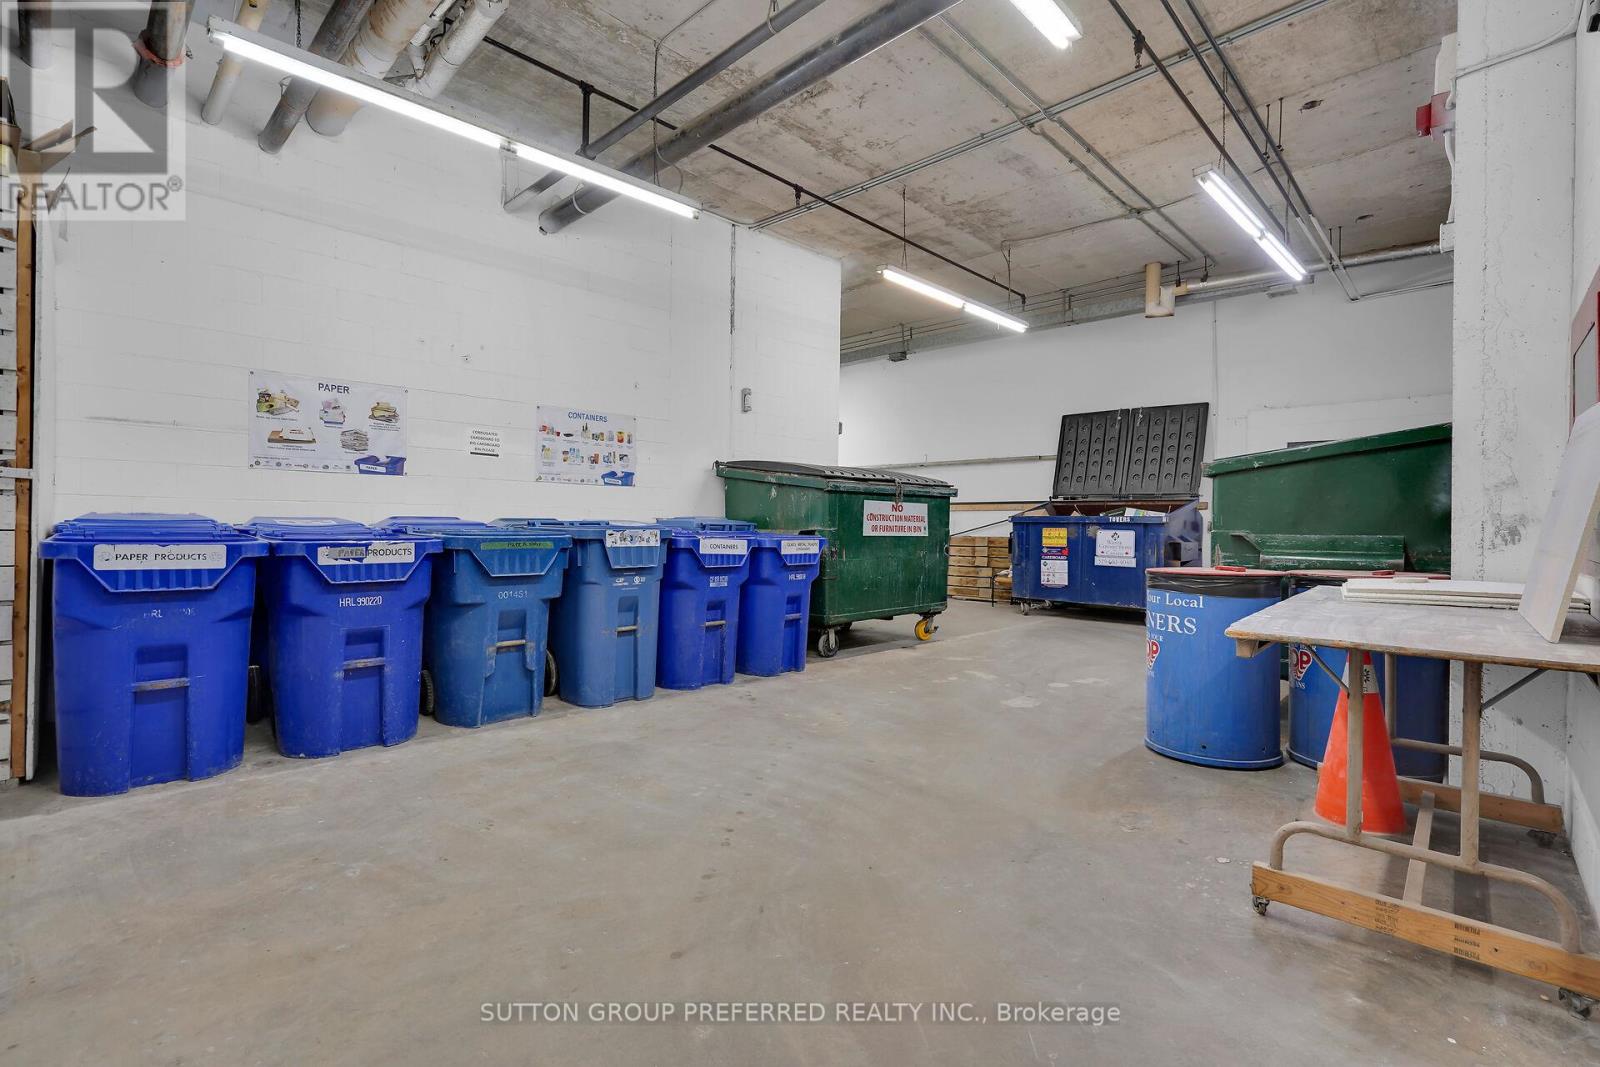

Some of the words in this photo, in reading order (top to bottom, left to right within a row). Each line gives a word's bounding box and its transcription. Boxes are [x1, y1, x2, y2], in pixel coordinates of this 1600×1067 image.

[318, 382, 350, 394] PAPER
[567, 411, 608, 423] CONTAINERS
[866, 513, 903, 522] CONSTRUCTION
[903, 514, 926, 523] MATERIAL
[871, 524, 879, 532] OR
[879, 525, 907, 533] FURNITURE
[115, 552, 148, 561] PAPER
[154, 552, 207, 561] PRODUCTS
[367, 548, 412, 557] PRODUCTS
[1147, 594, 1161, 604] our
[1165, 592, 1205, 609] Local
[1146, 610, 1197, 635] NERS
